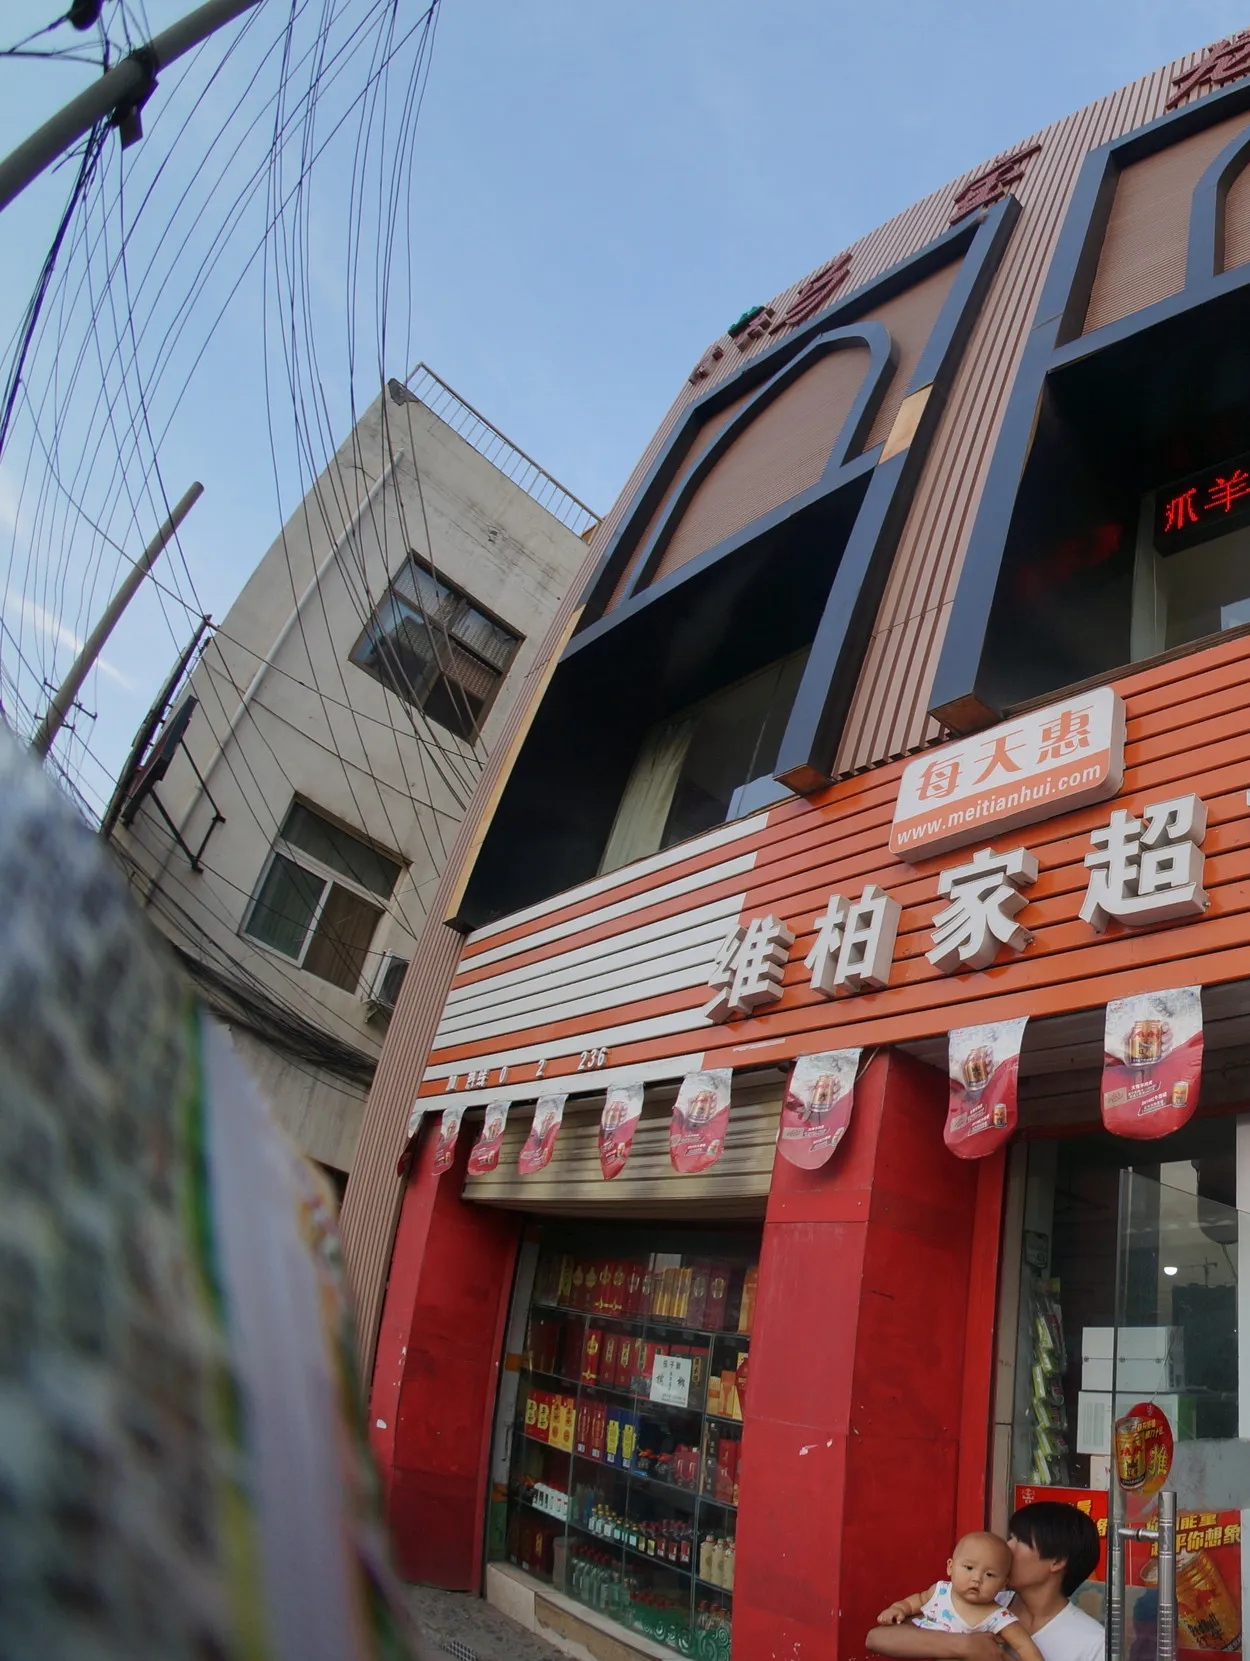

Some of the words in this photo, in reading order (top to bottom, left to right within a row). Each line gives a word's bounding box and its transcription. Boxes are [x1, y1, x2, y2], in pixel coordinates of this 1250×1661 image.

[915, 705, 1094, 801] 每天惠
[896, 764, 1101, 846] www.meitianhui.com
[577, 1047, 609, 1071] 236
